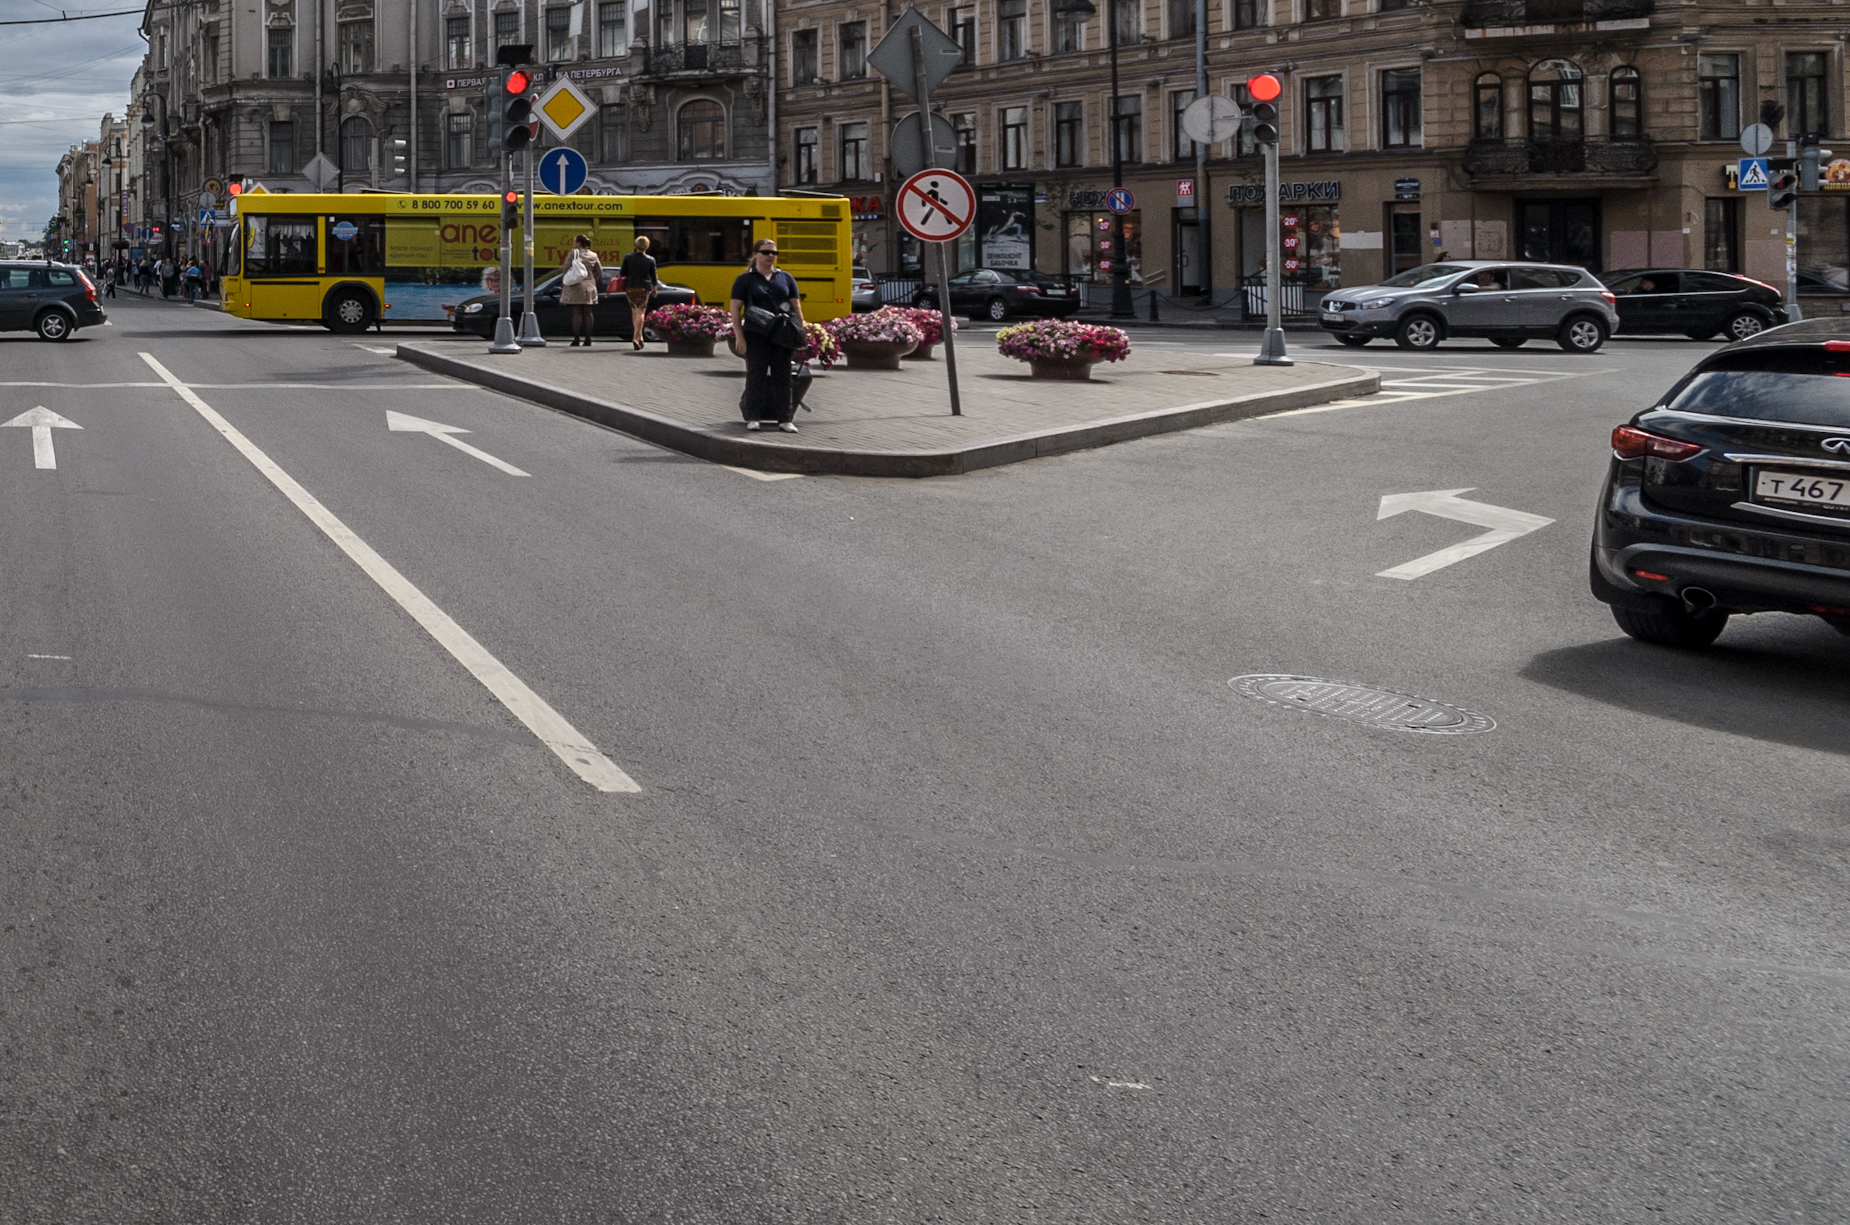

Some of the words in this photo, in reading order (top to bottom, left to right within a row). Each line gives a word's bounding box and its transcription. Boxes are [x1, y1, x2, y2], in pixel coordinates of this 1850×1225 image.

[457, 78, 486, 87] ПЕРВАЯ
[571, 67, 622, 79] ПЕТЕРБУРГА
[412, 200, 419, 209] 8
[422, 200, 441, 209] 800
[444, 200, 463, 209] 700
[466, 200, 478, 210] 59
[482, 200, 495, 210] 60
[1790, 478, 1844, 501] 467
